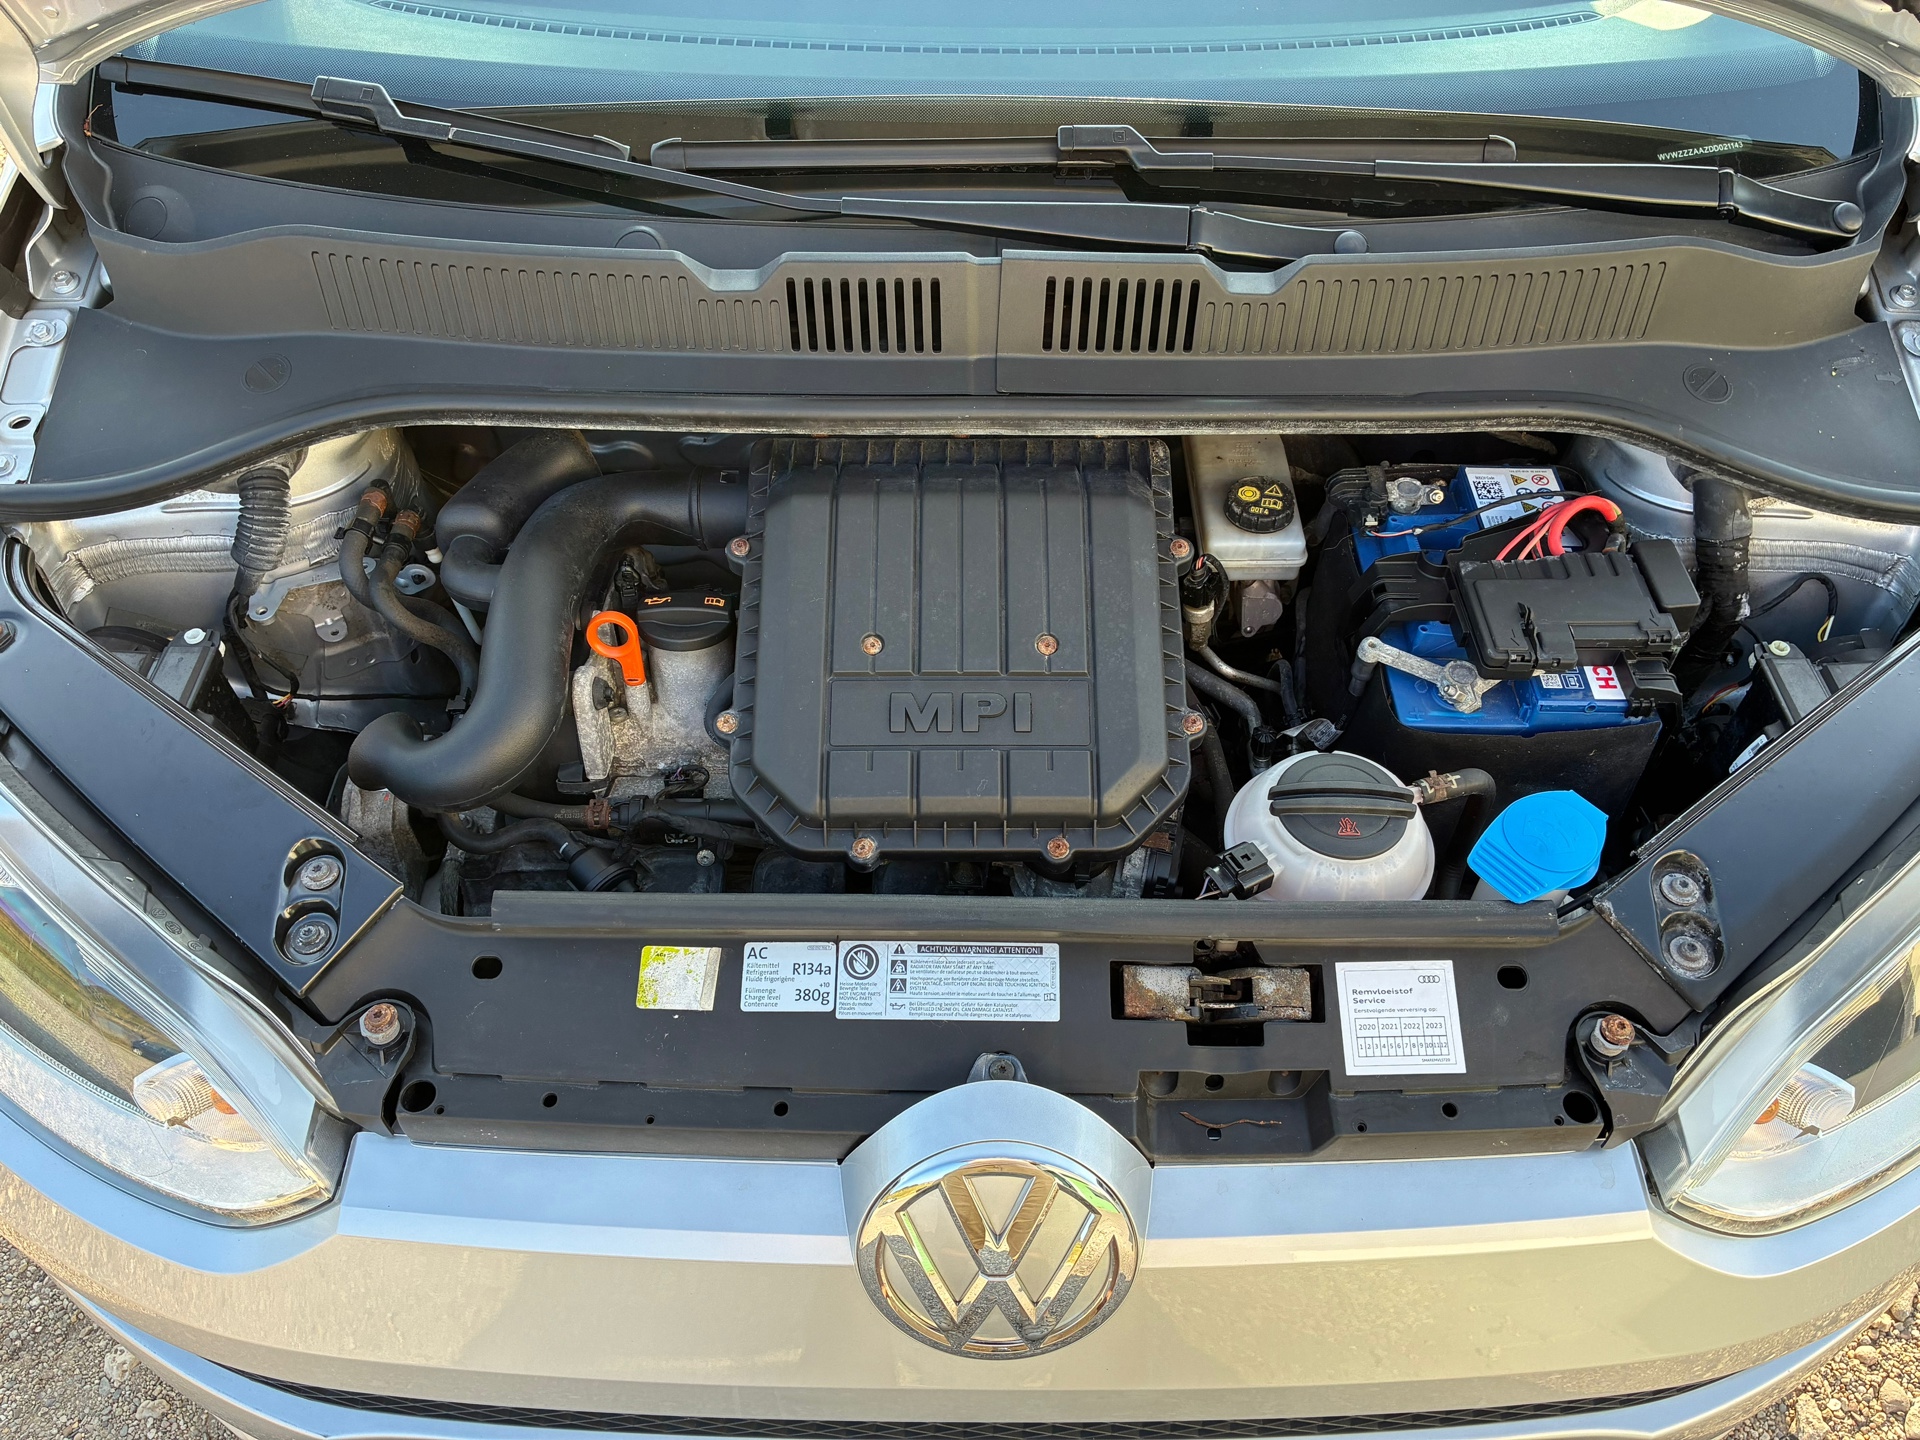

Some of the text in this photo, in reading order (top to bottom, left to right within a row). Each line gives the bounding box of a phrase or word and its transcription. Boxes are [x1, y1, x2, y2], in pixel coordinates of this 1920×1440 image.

[1657, 141, 1744, 160] WVWZZZAAZDD021143
[889, 692, 1032, 733] MPI
[747, 947, 768, 959] AC
[793, 963, 831, 975] R134a
[795, 989, 830, 1006] 380g
[862, 1156, 1136, 1356] VW
